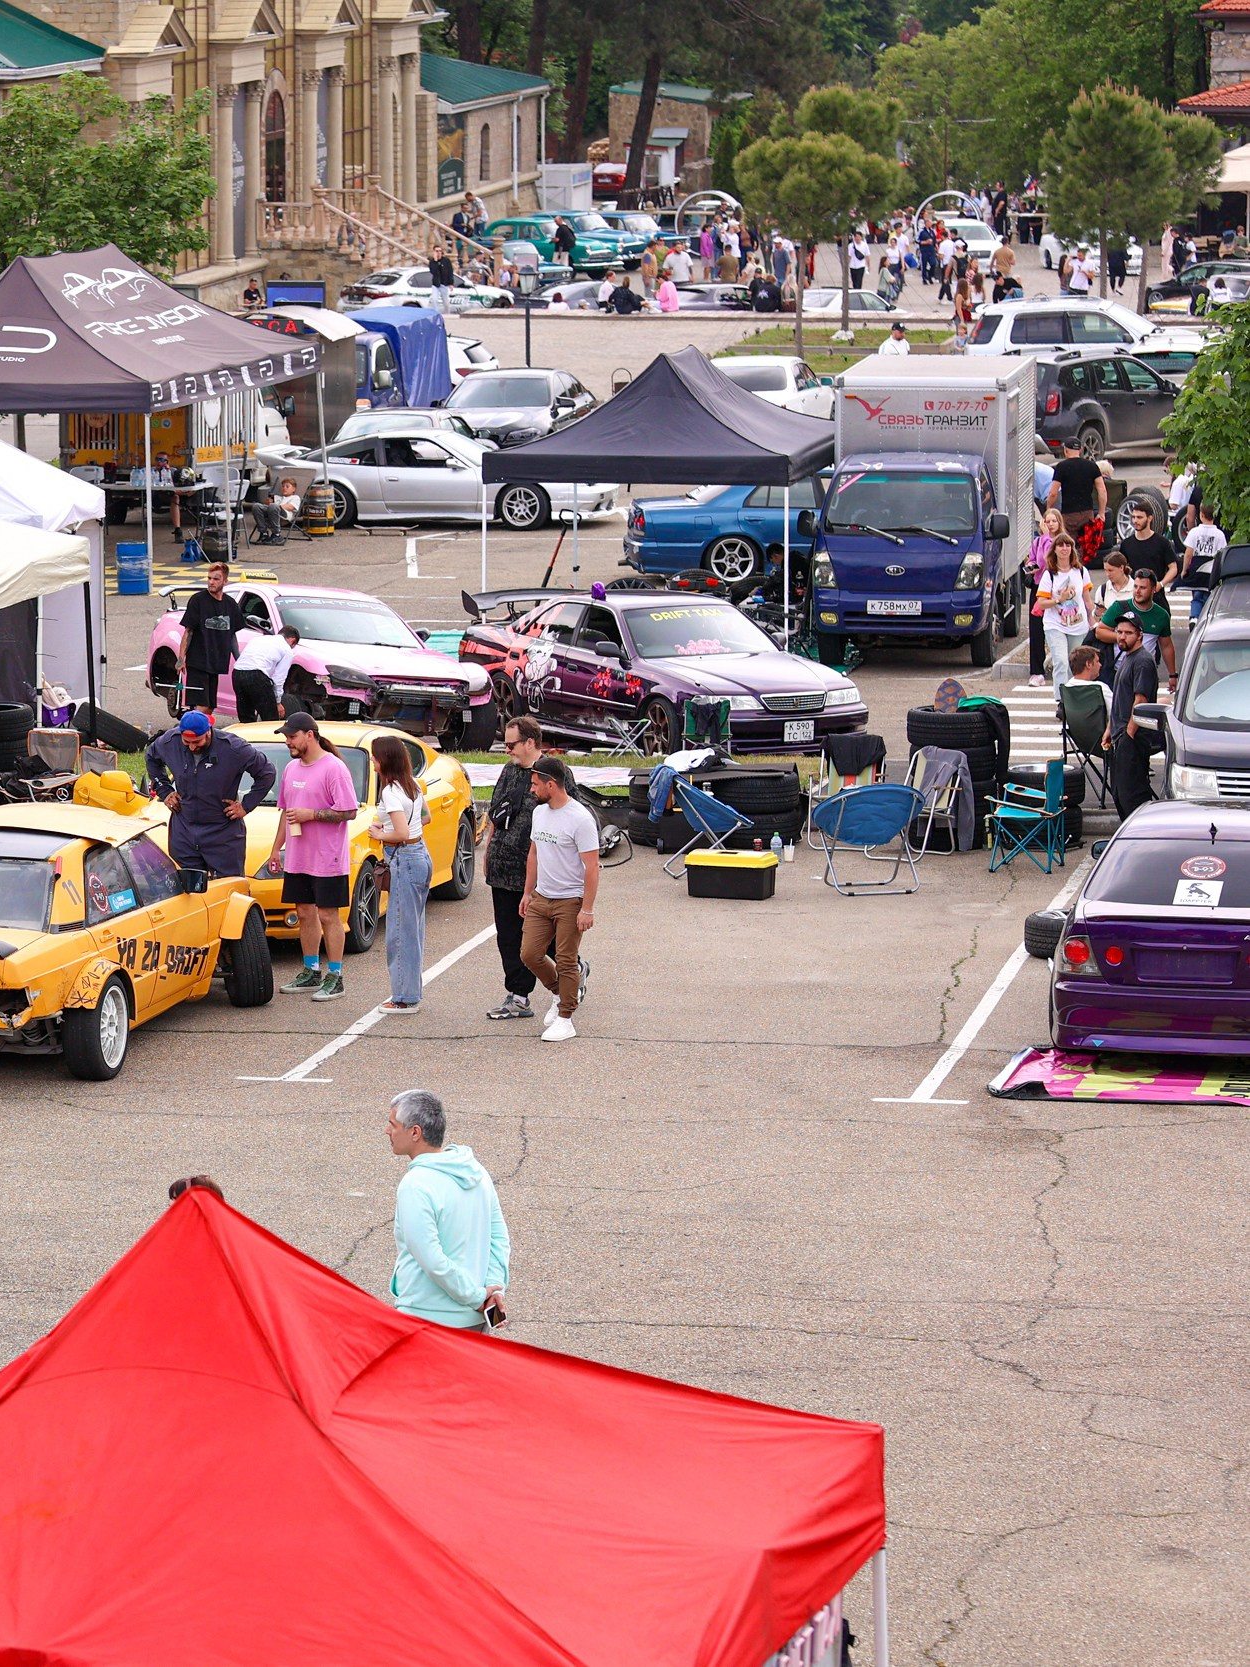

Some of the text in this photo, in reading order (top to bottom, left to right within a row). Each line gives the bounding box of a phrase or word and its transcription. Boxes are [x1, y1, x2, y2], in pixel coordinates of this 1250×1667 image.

[937, 401, 989, 411] 70-77-70
[650, 608, 725, 622] DRIFT TAXI
[796, 721, 810, 730] 590
